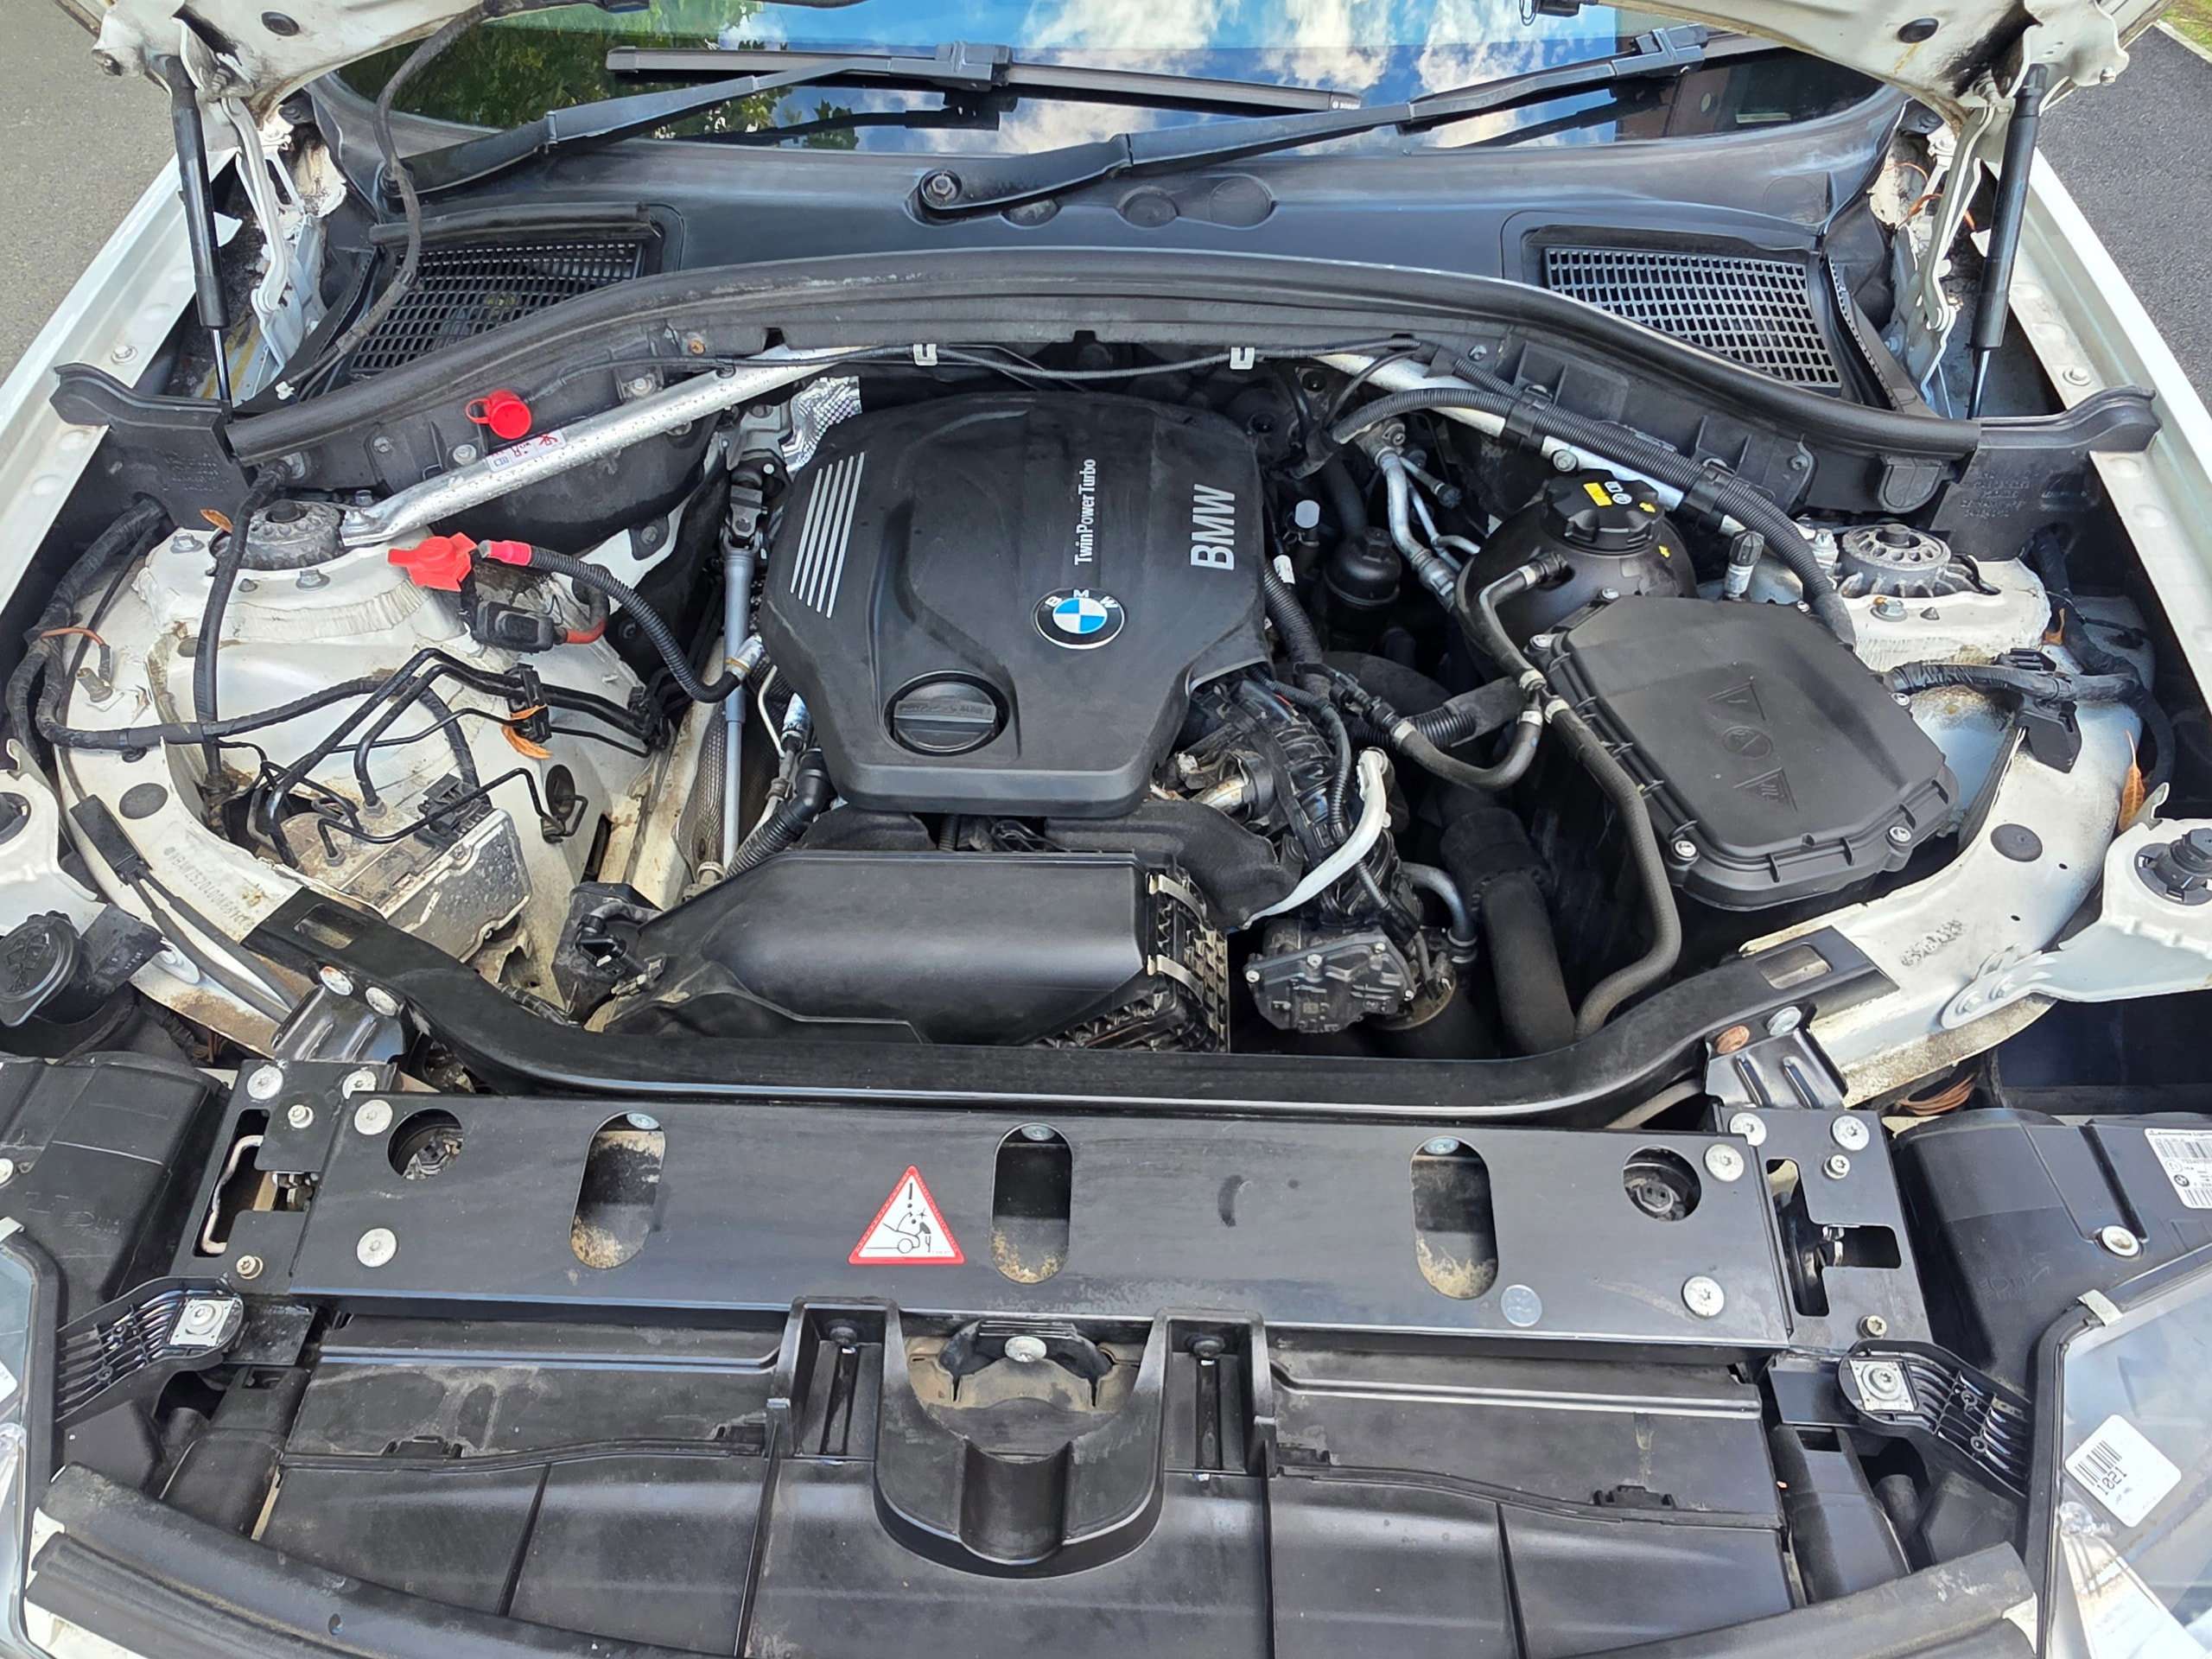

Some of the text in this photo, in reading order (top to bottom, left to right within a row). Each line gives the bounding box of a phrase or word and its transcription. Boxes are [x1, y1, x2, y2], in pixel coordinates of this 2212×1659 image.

[1074, 458, 1096, 565] TwinPower Turbo
[1191, 484, 1236, 571] BMW
[1044, 588, 1120, 608] BMW
[2097, 1466, 2128, 1496] 1021
